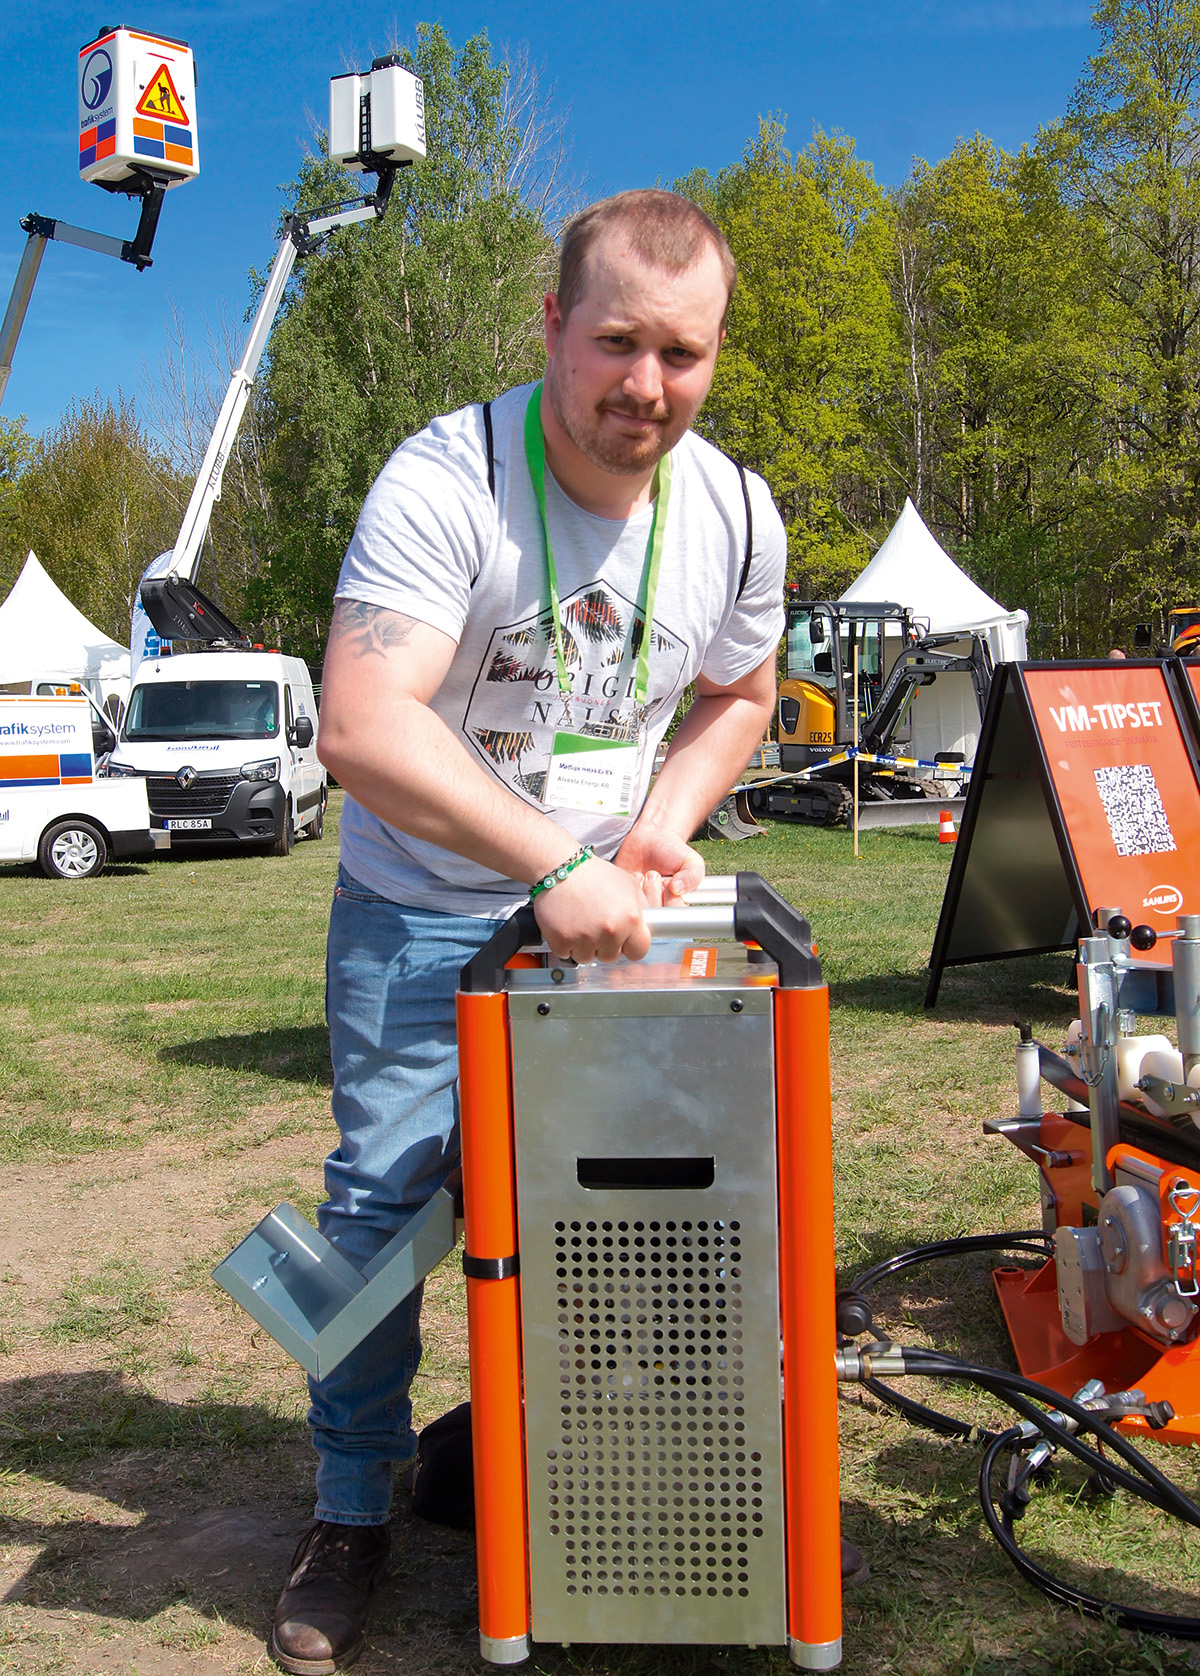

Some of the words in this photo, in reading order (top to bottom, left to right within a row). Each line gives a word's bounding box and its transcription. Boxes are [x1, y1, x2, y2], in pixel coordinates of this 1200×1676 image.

[81, 106, 114, 128] trafiksystem
[414, 79, 426, 147] KLUBB
[554, 695, 611, 706] JK&JONES
[1048, 701, 1163, 732] VM-TIPSET
[0, 722, 76, 737] rafiksystem
[809, 732, 832, 743] ECR25
[171, 820, 188, 829] RLC
[191, 820, 208, 828] 85A
[1142, 893, 1177, 907] SAHLINS
